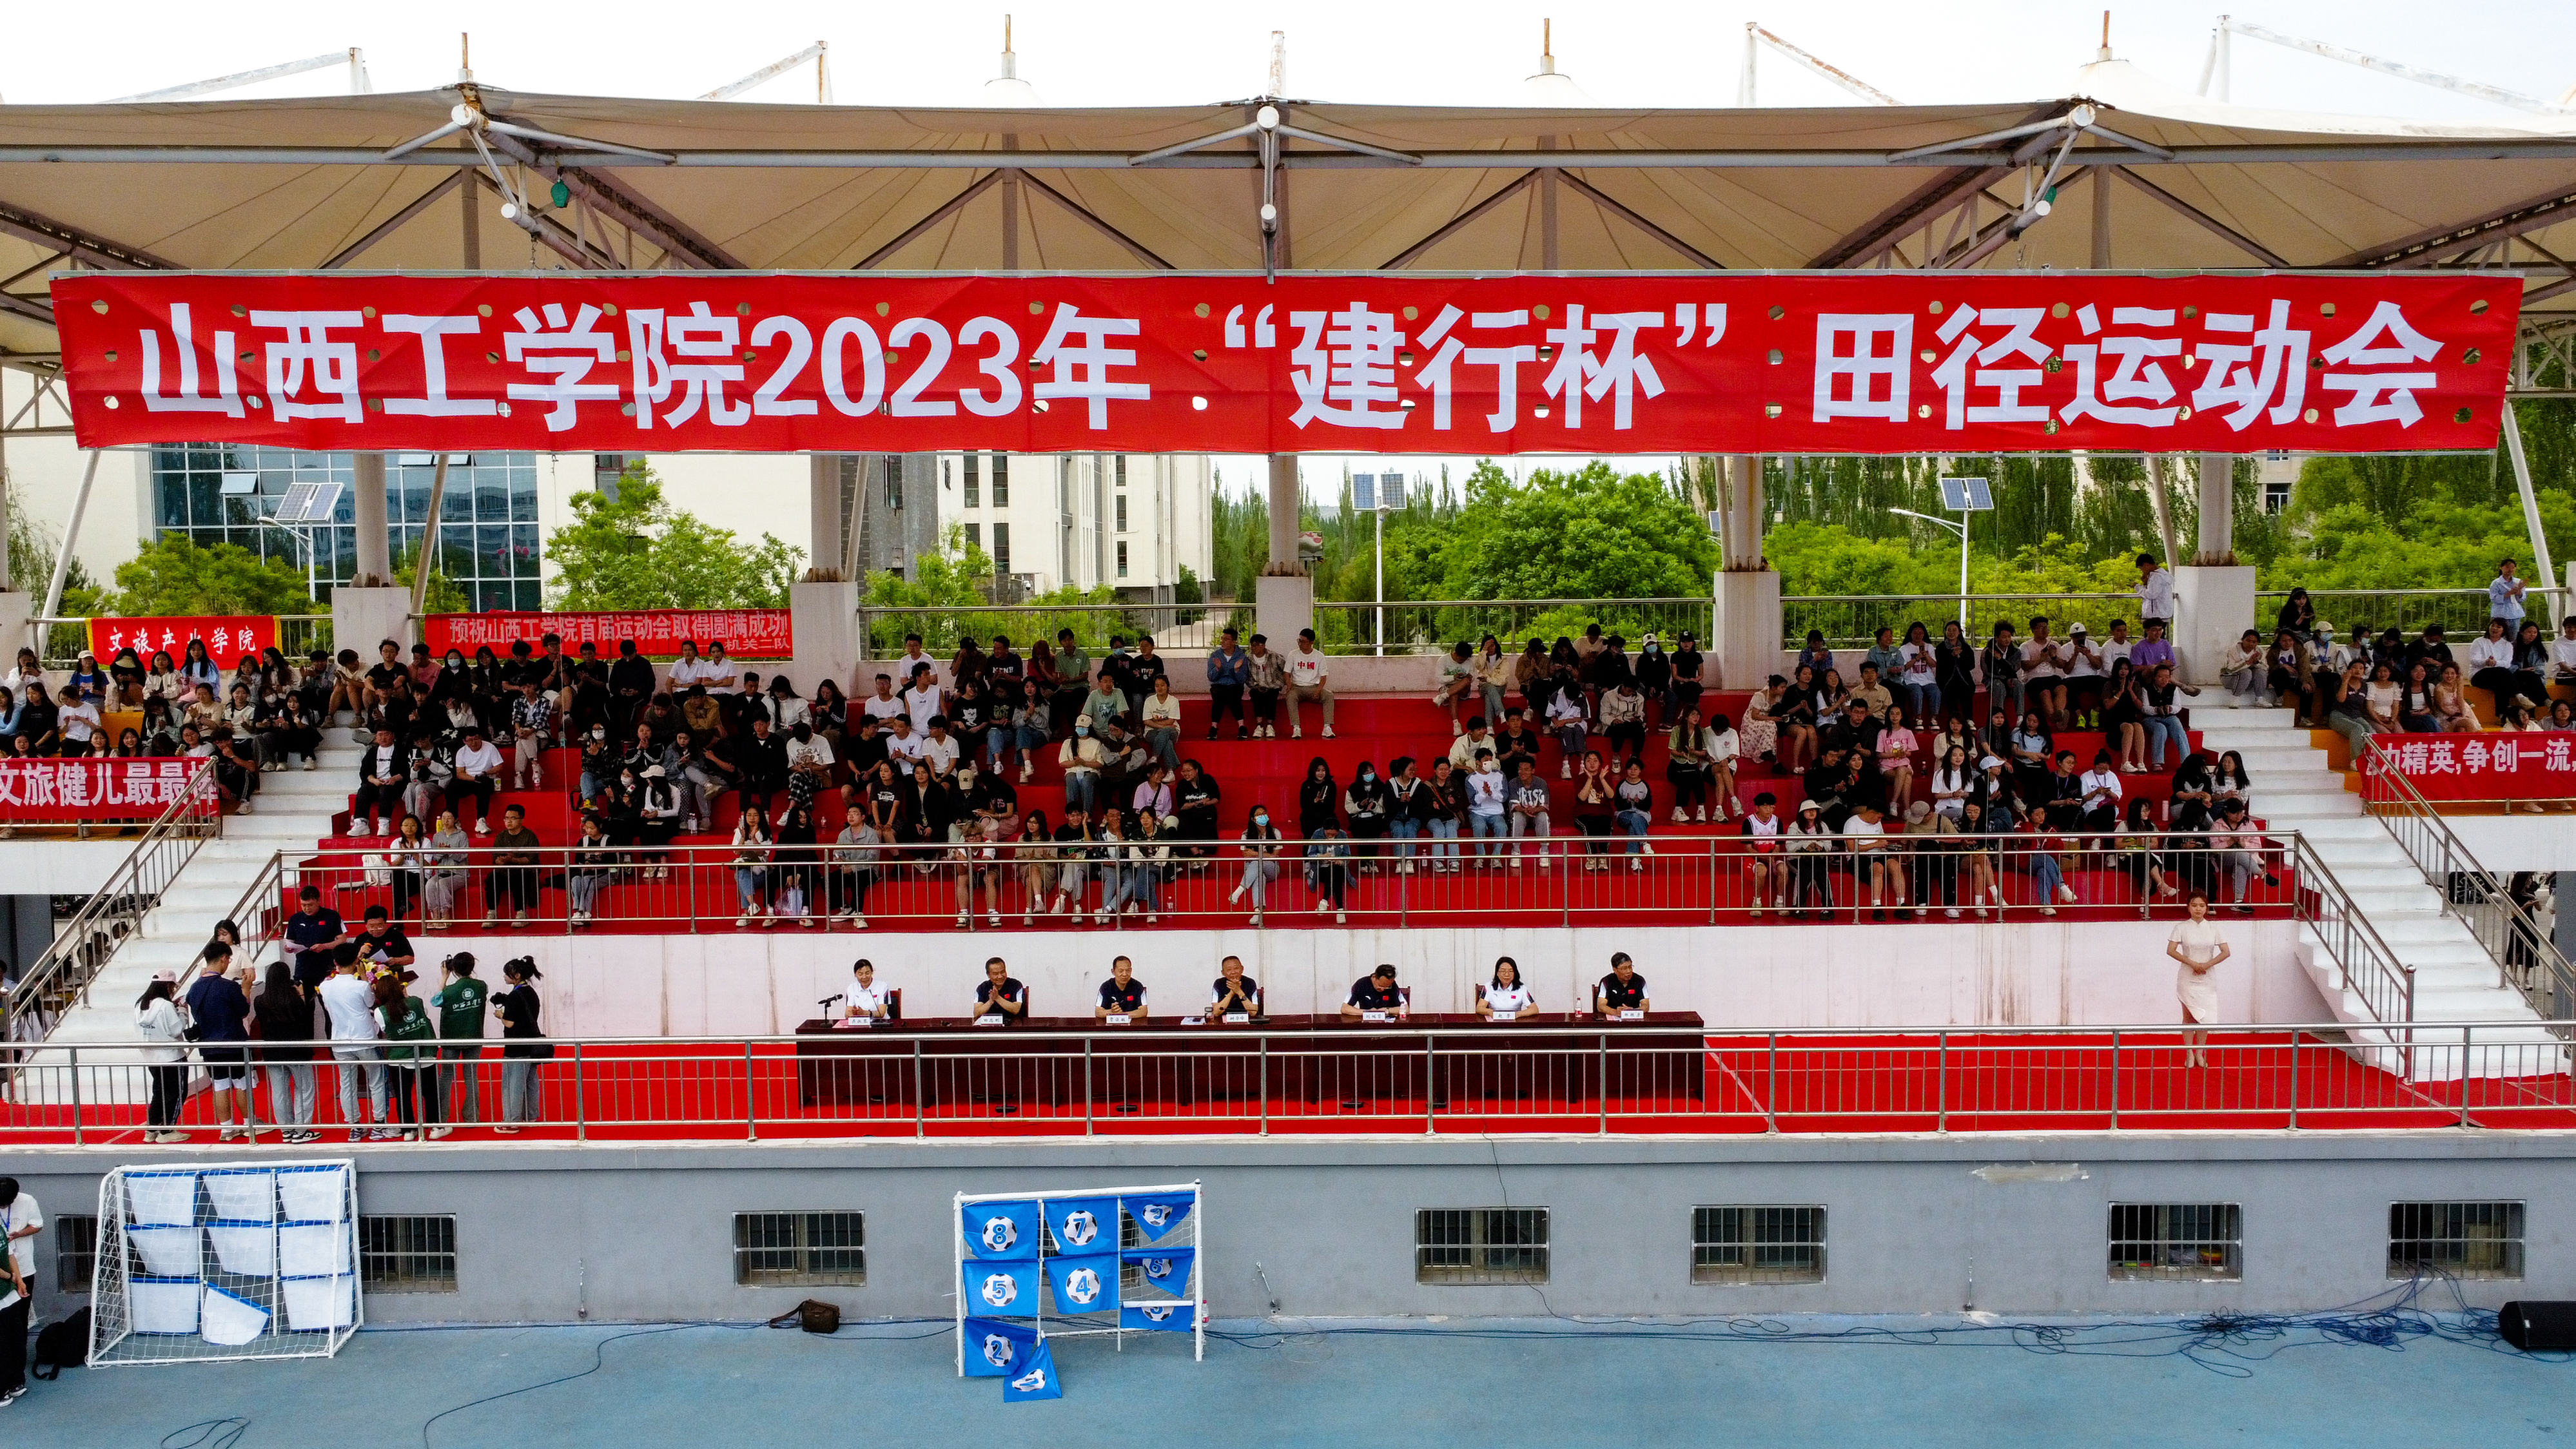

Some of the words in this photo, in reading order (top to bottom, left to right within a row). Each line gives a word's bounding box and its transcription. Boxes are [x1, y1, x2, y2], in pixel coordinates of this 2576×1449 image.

[1298, 661, 1315, 670] 中國
[0, 761, 218, 806] 文旅健儿最最棒
[992, 1223, 1007, 1245] 8
[1073, 1218, 1086, 1239] 7
[992, 1279, 1007, 1300] 5
[1075, 1275, 1091, 1296] 4
[991, 1339, 1004, 1361] 2
